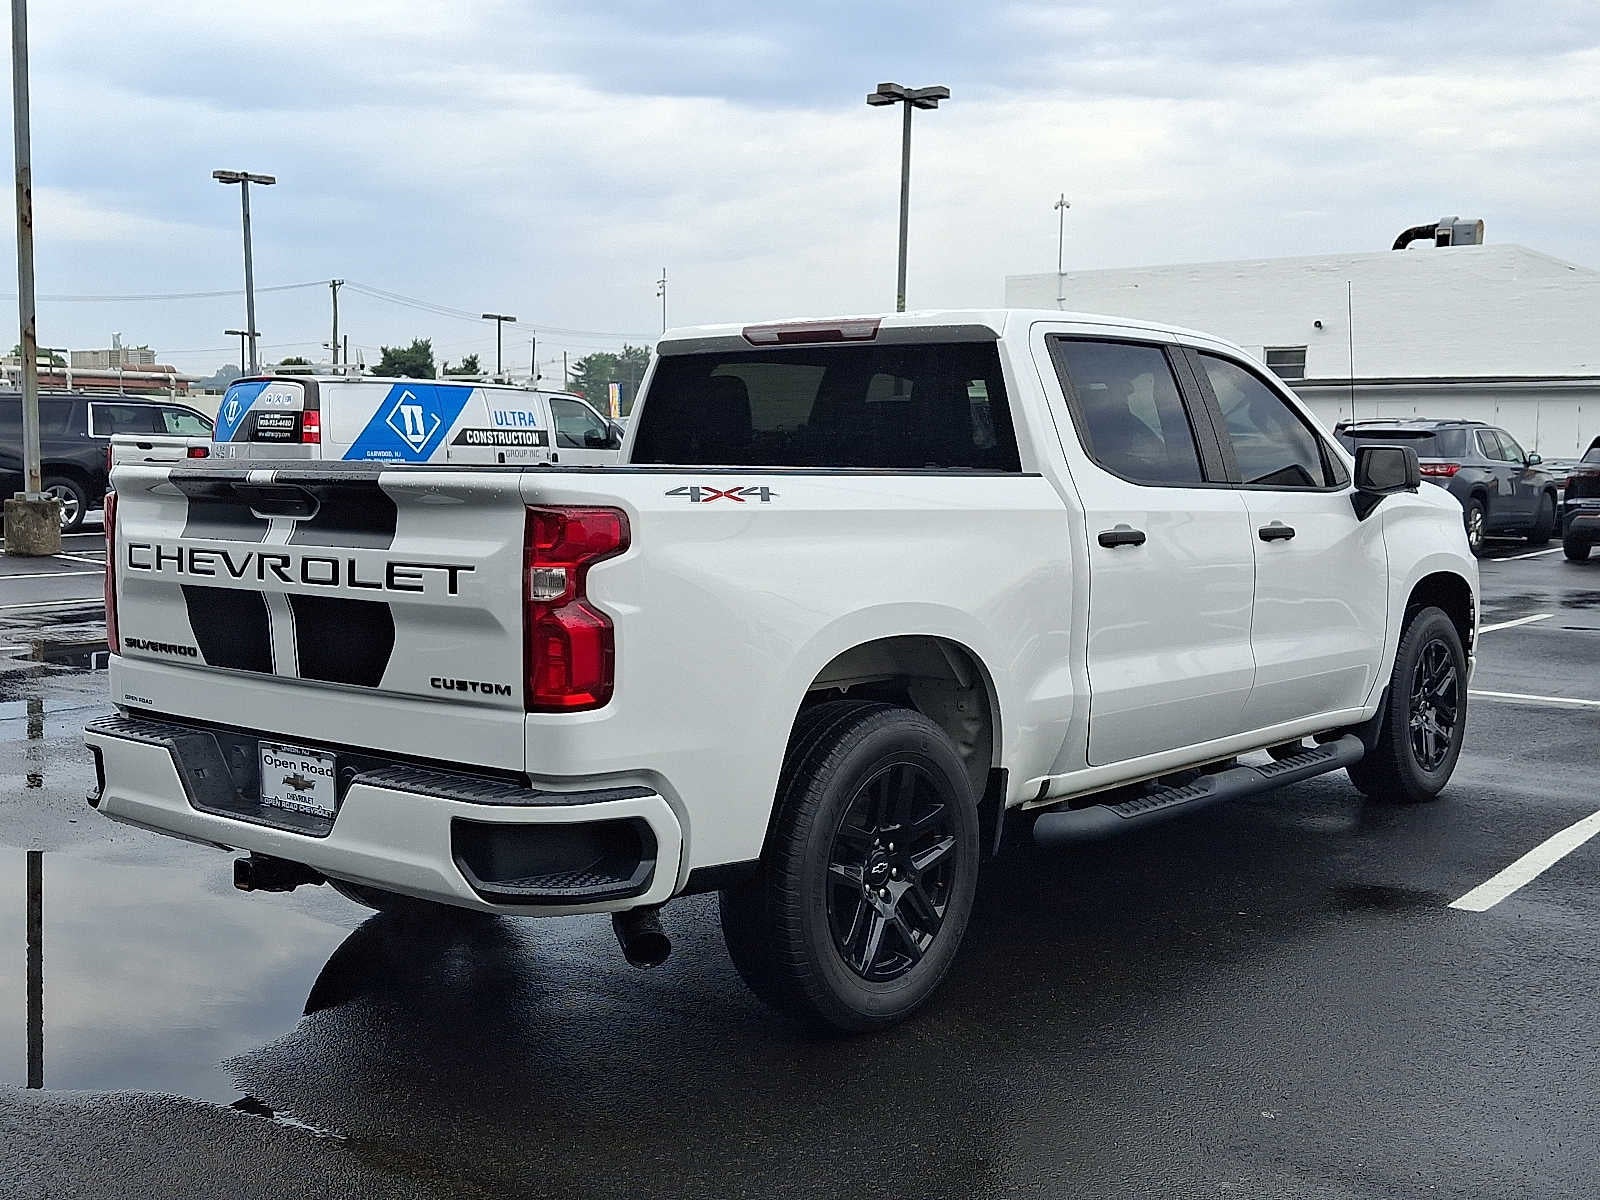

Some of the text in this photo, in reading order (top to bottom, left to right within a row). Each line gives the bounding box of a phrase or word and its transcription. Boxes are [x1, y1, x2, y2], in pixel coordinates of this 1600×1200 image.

[494, 410, 537, 427] ULTRA
[466, 430, 540, 445] CONSTRUCTION
[505, 450, 540, 458] GROUP INC
[127, 542, 476, 596] CHEVROLET
[124, 637, 198, 657] SILVERADO
[430, 677, 511, 696] CUSTOM
[263, 754, 334, 778] Open Road
[264, 798, 281, 807] OPEN
[281, 801, 298, 811] ROAD
